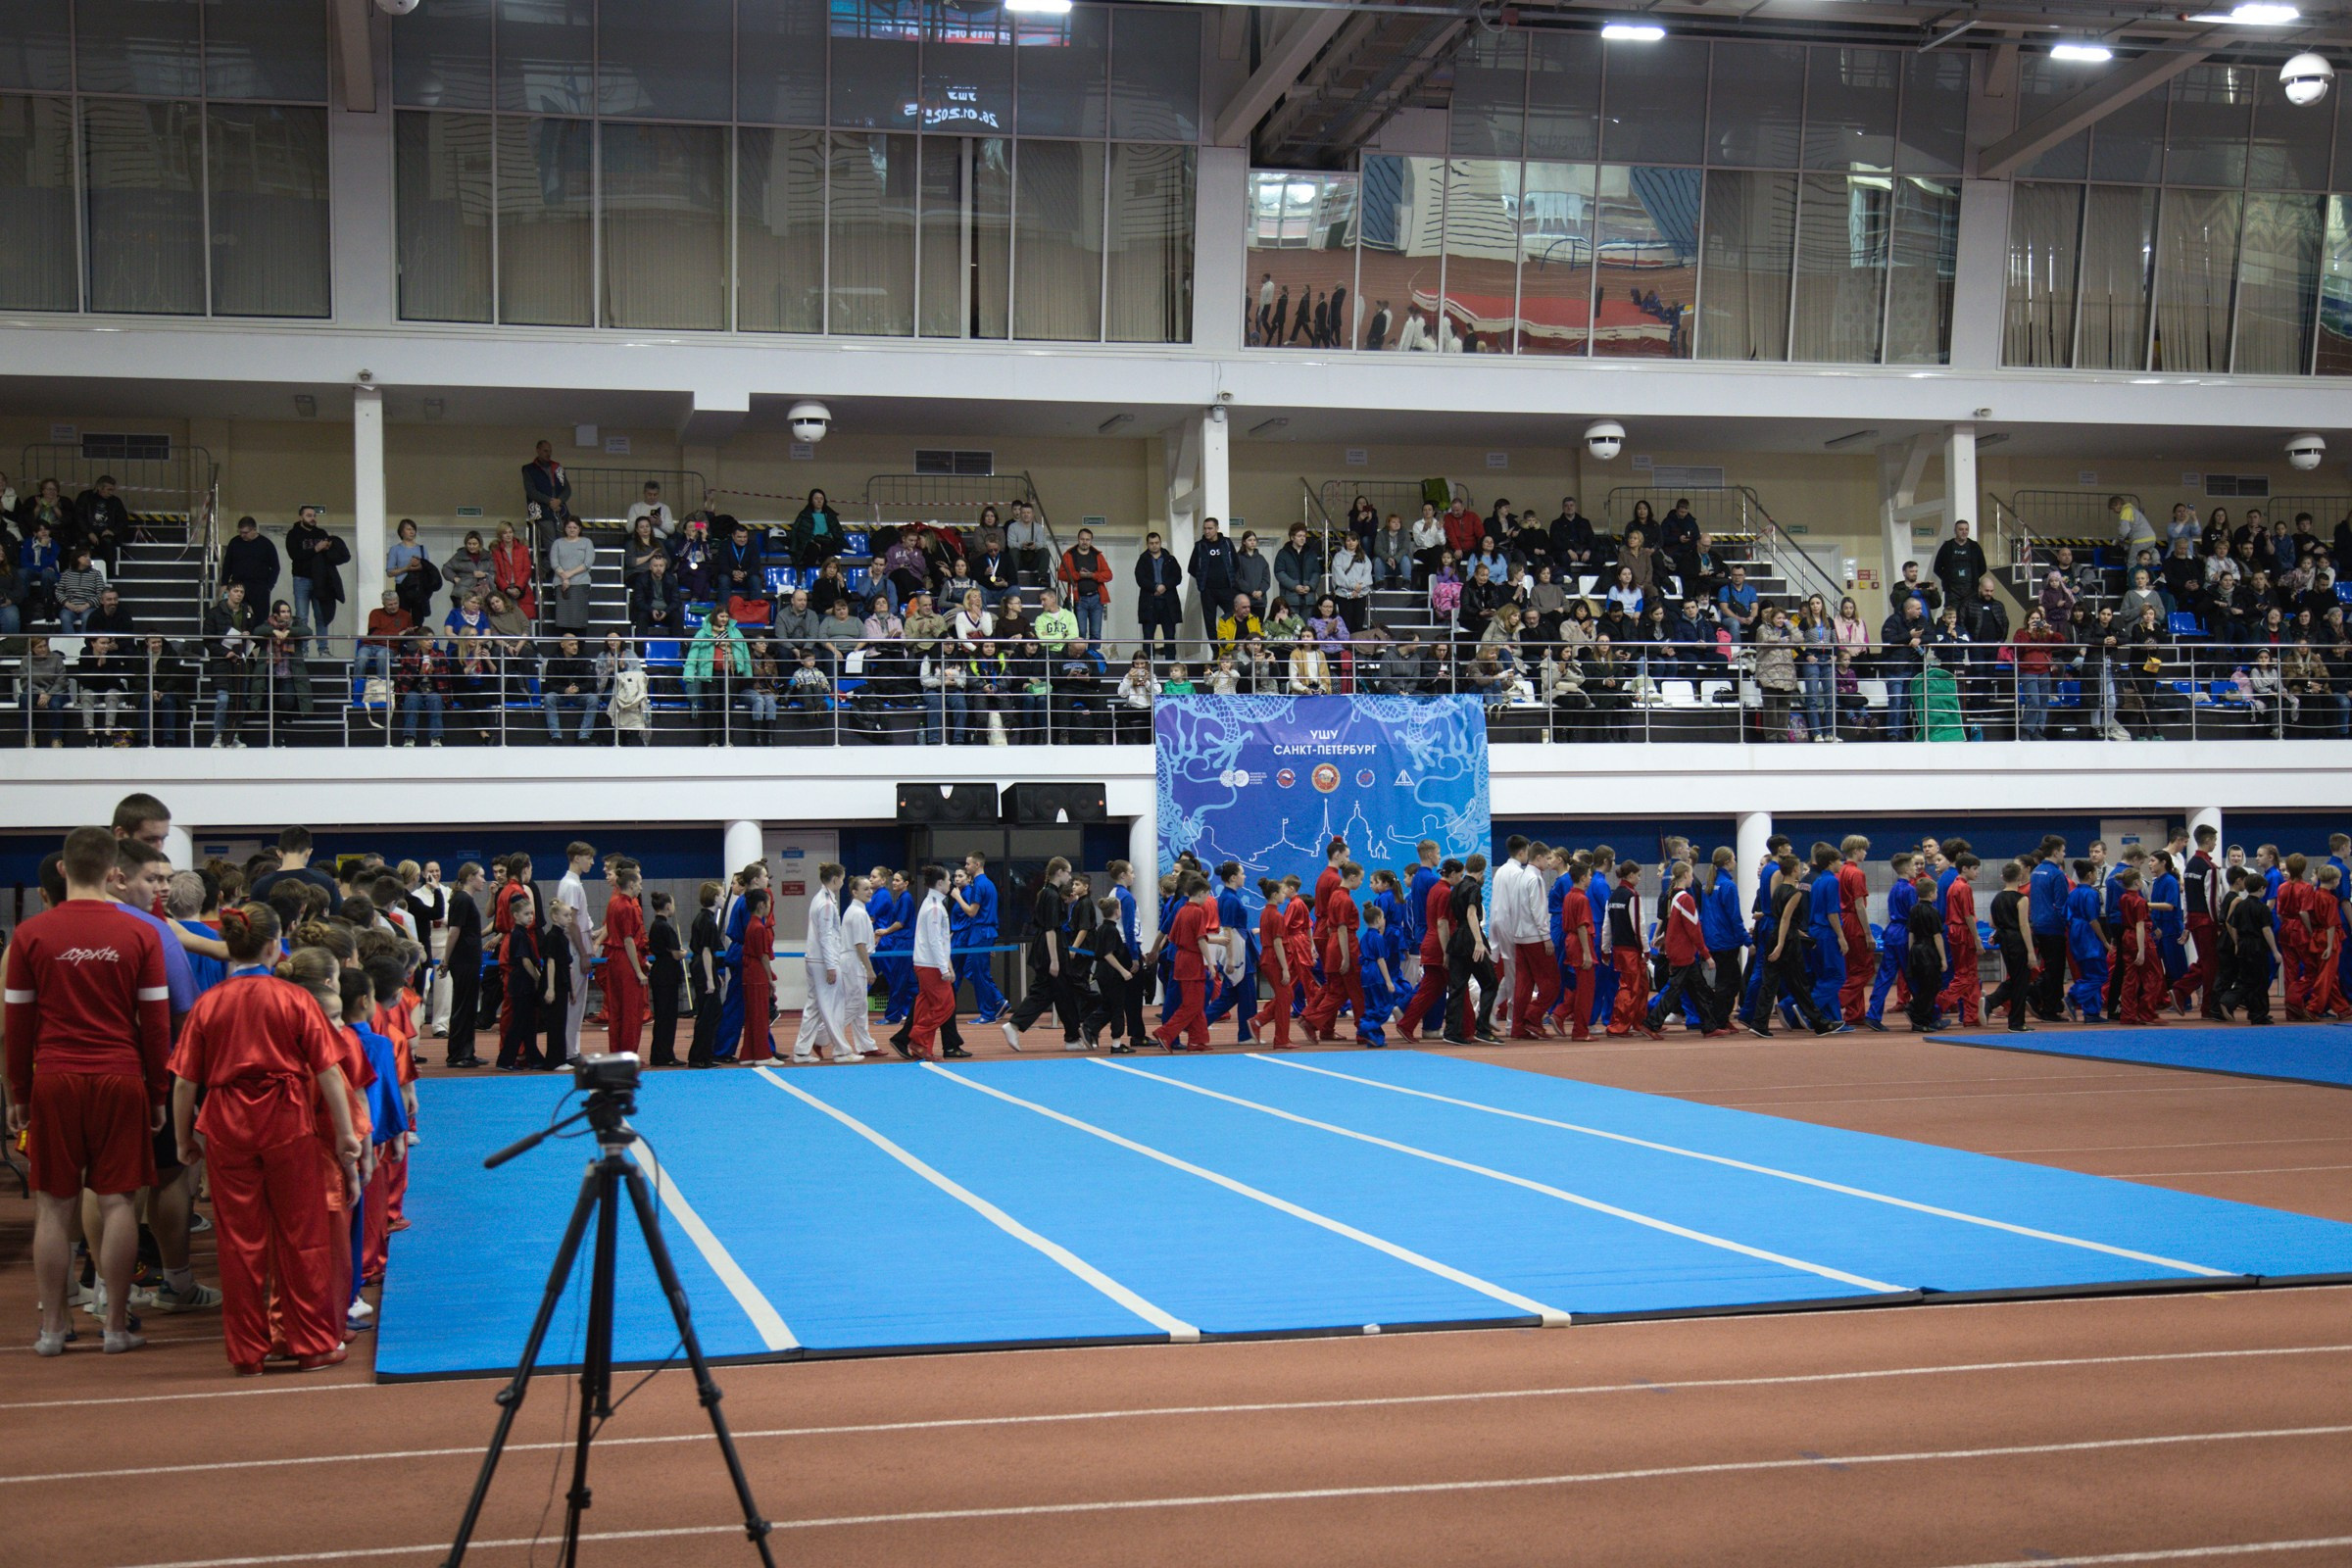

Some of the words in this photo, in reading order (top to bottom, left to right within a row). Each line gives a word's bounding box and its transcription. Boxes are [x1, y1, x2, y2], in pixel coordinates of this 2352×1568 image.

[1046, 620, 1067, 633] GAP
[1310, 730, 1339, 739] УШУ
[1273, 745, 1377, 755] САНКТ-ПЕТЕРБУРГ
